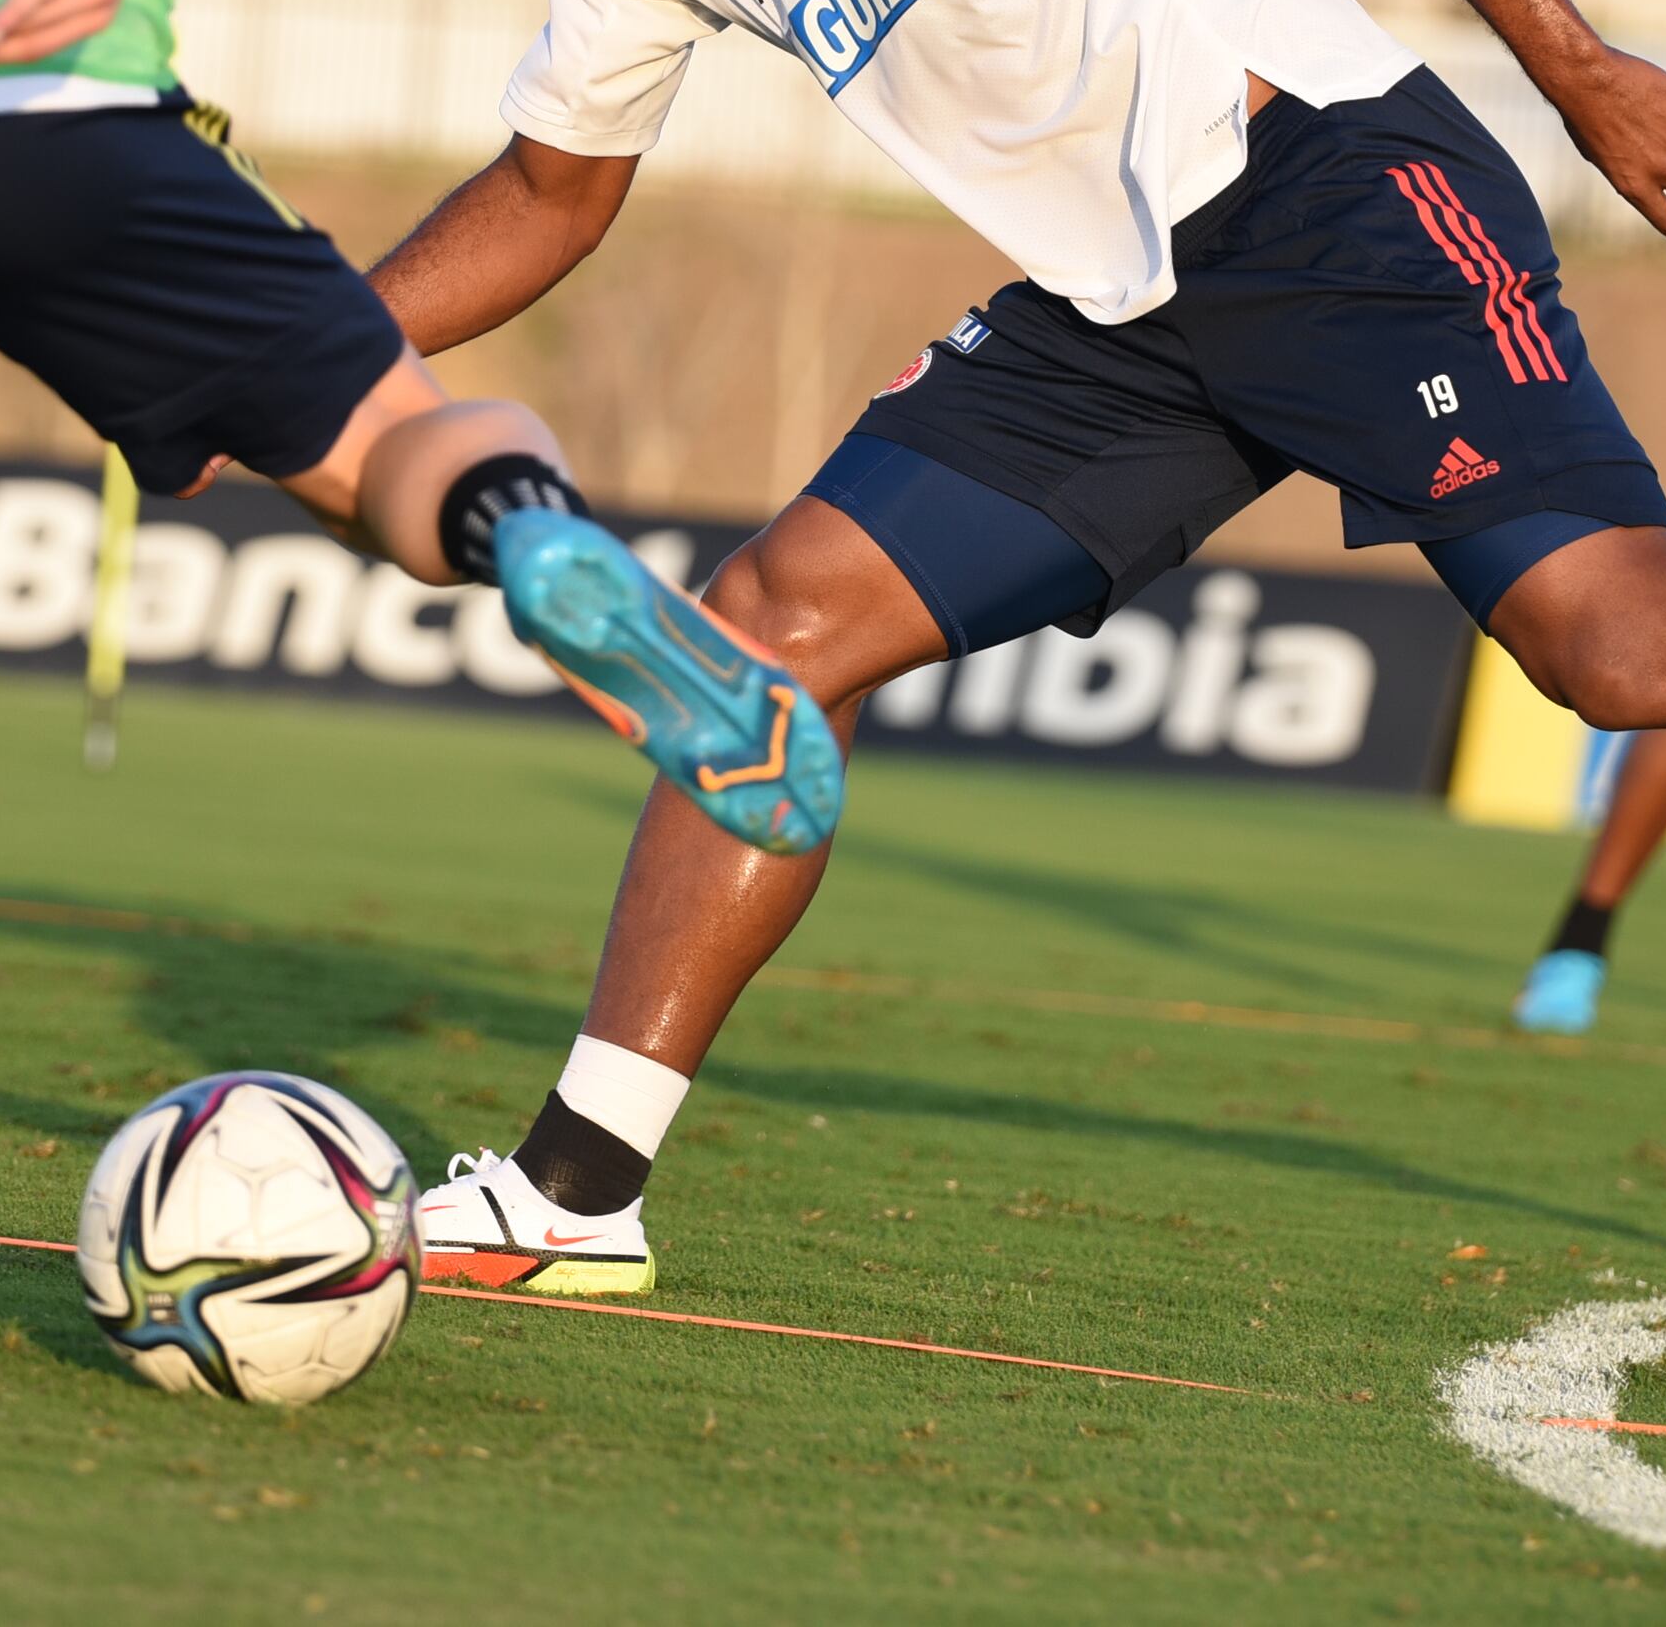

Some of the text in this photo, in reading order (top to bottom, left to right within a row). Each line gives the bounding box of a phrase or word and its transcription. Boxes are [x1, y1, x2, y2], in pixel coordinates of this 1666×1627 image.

[948, 315, 983, 349] ILA
[1416, 373, 1459, 420] 19
[1429, 459, 1501, 500] adidas
